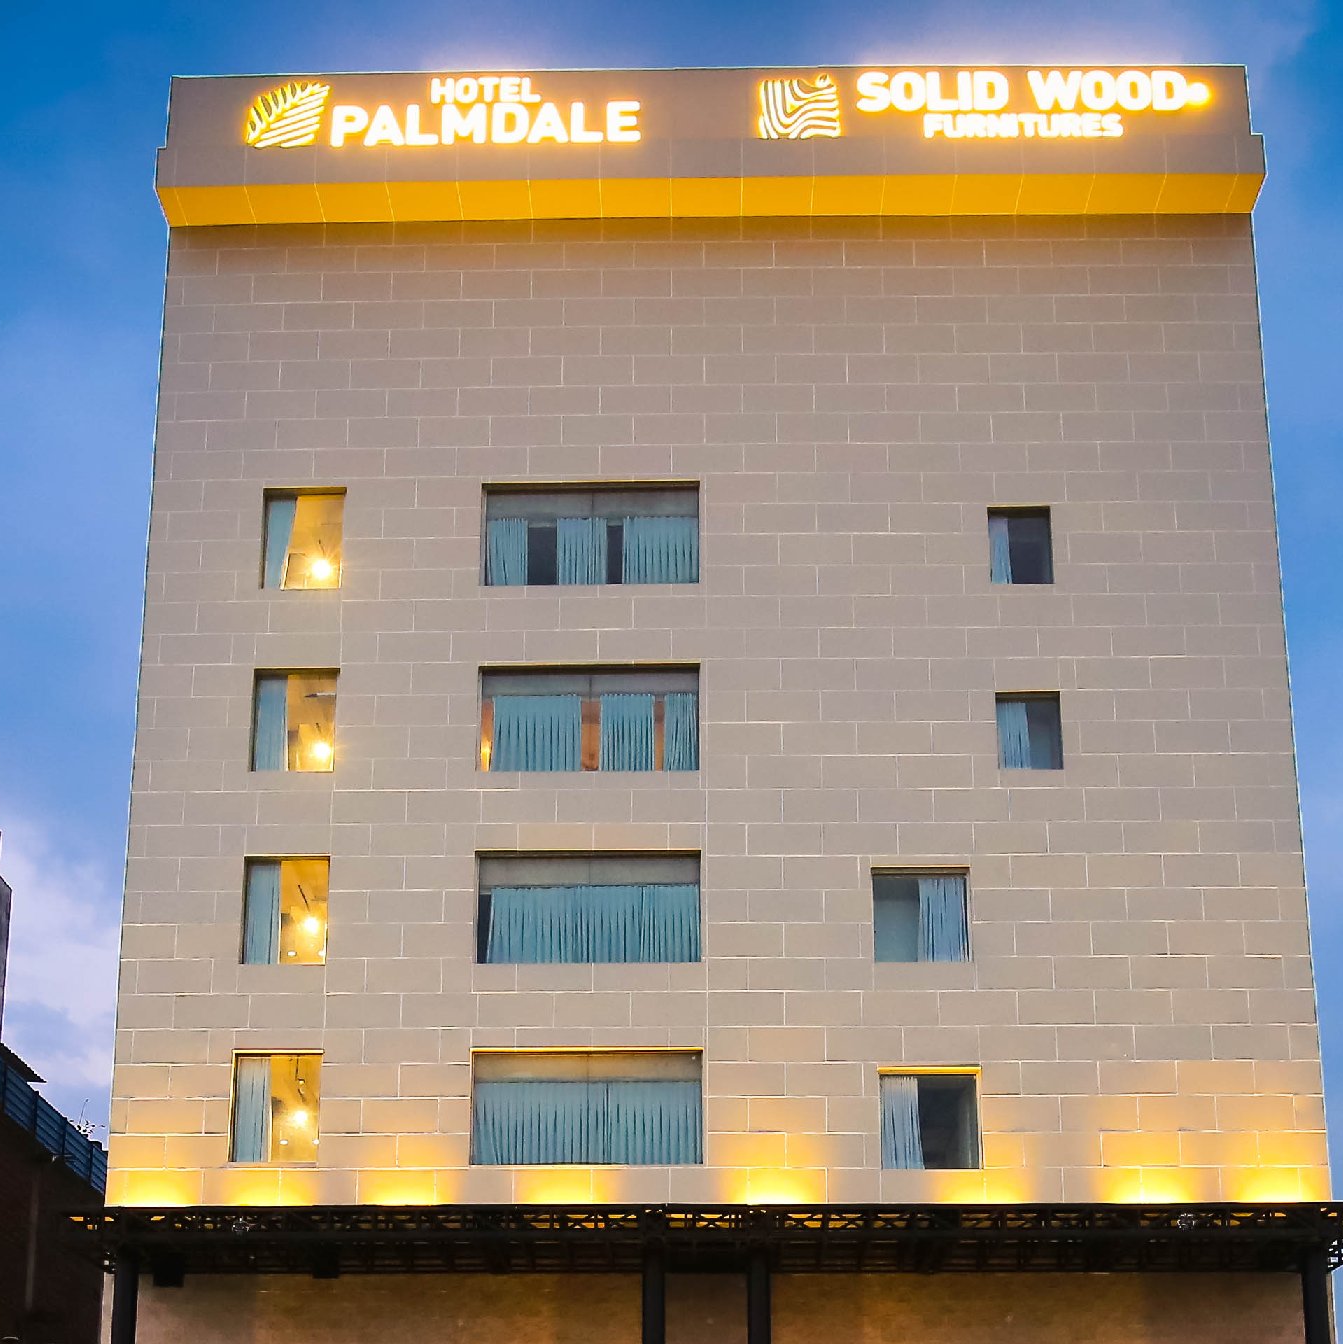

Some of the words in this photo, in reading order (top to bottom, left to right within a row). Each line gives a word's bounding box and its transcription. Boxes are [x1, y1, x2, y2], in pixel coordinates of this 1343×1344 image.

[431, 77, 541, 104] HOTEL
[856, 70, 1009, 112] SOLID
[330, 101, 641, 147] PALMDALE
[923, 113, 1123, 138] FURNITURES
